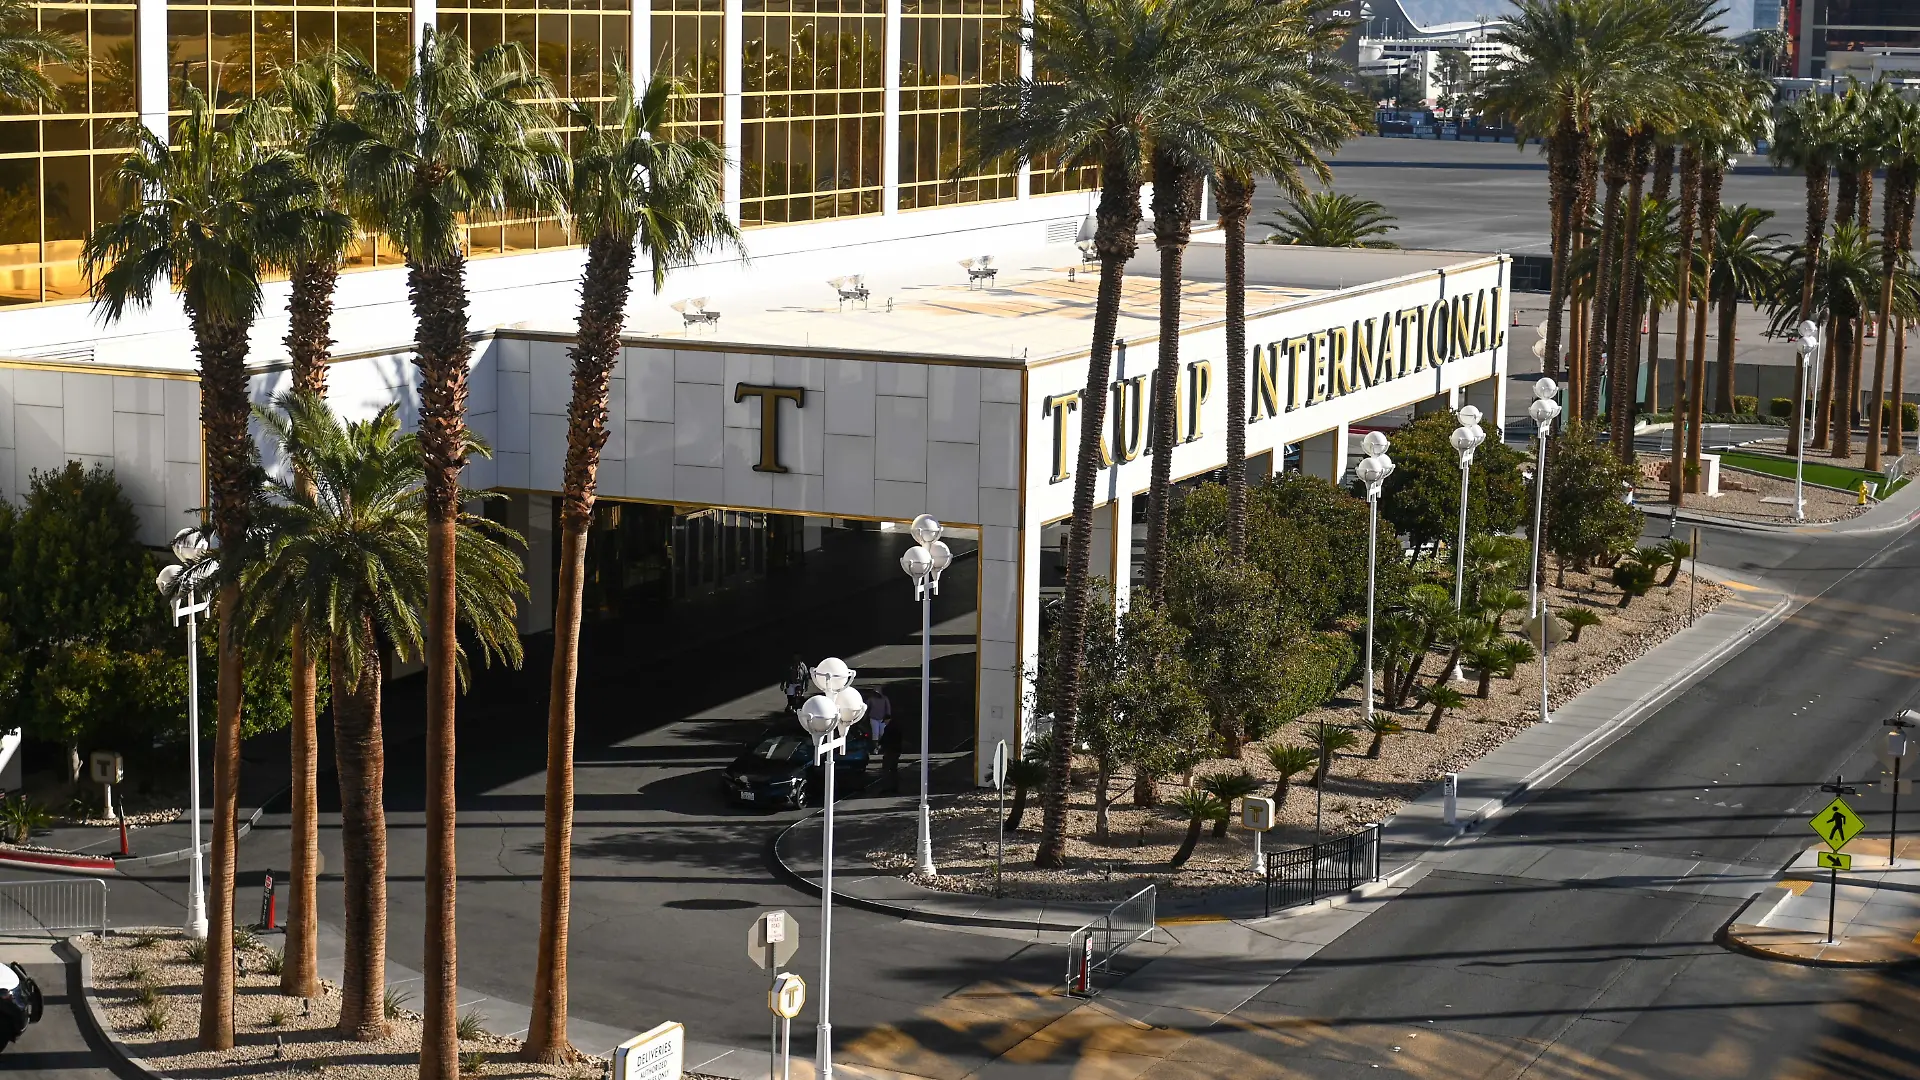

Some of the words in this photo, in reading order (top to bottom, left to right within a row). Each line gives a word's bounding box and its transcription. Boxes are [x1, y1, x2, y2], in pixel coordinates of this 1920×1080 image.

[1043, 359, 1212, 485] TUP
[1246, 286, 1504, 425] NTERNATIONAL
[734, 382, 804, 474] T
[97, 760, 111, 777] T
[1248, 805, 1264, 823] T
[785, 985, 799, 1008] T
[637, 1040, 672, 1067] DELIVERIES
